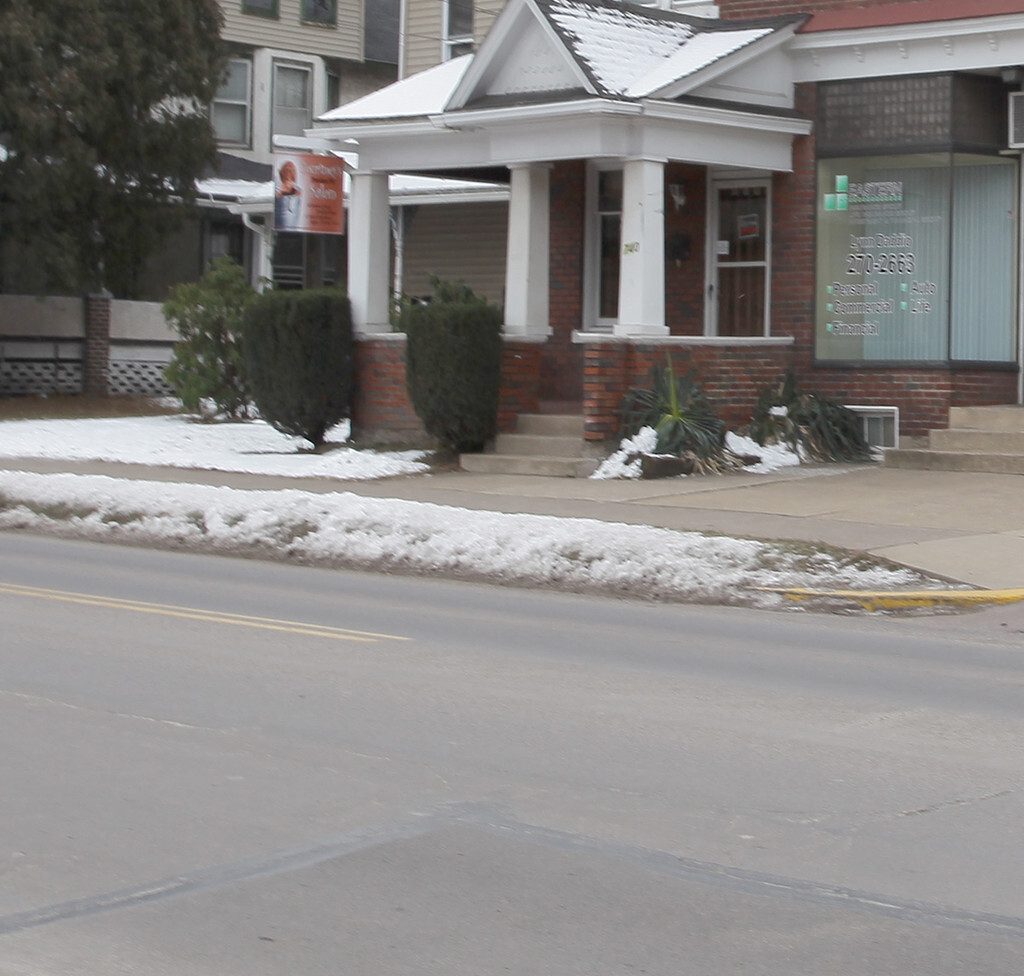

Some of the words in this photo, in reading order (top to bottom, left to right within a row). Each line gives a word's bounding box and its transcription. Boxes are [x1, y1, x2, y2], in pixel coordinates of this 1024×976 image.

[846, 252, 915, 274] 270-2663
[833, 280, 879, 296] Personal
[909, 280, 937, 295] Auto
[833, 298, 894, 315] Commercial
